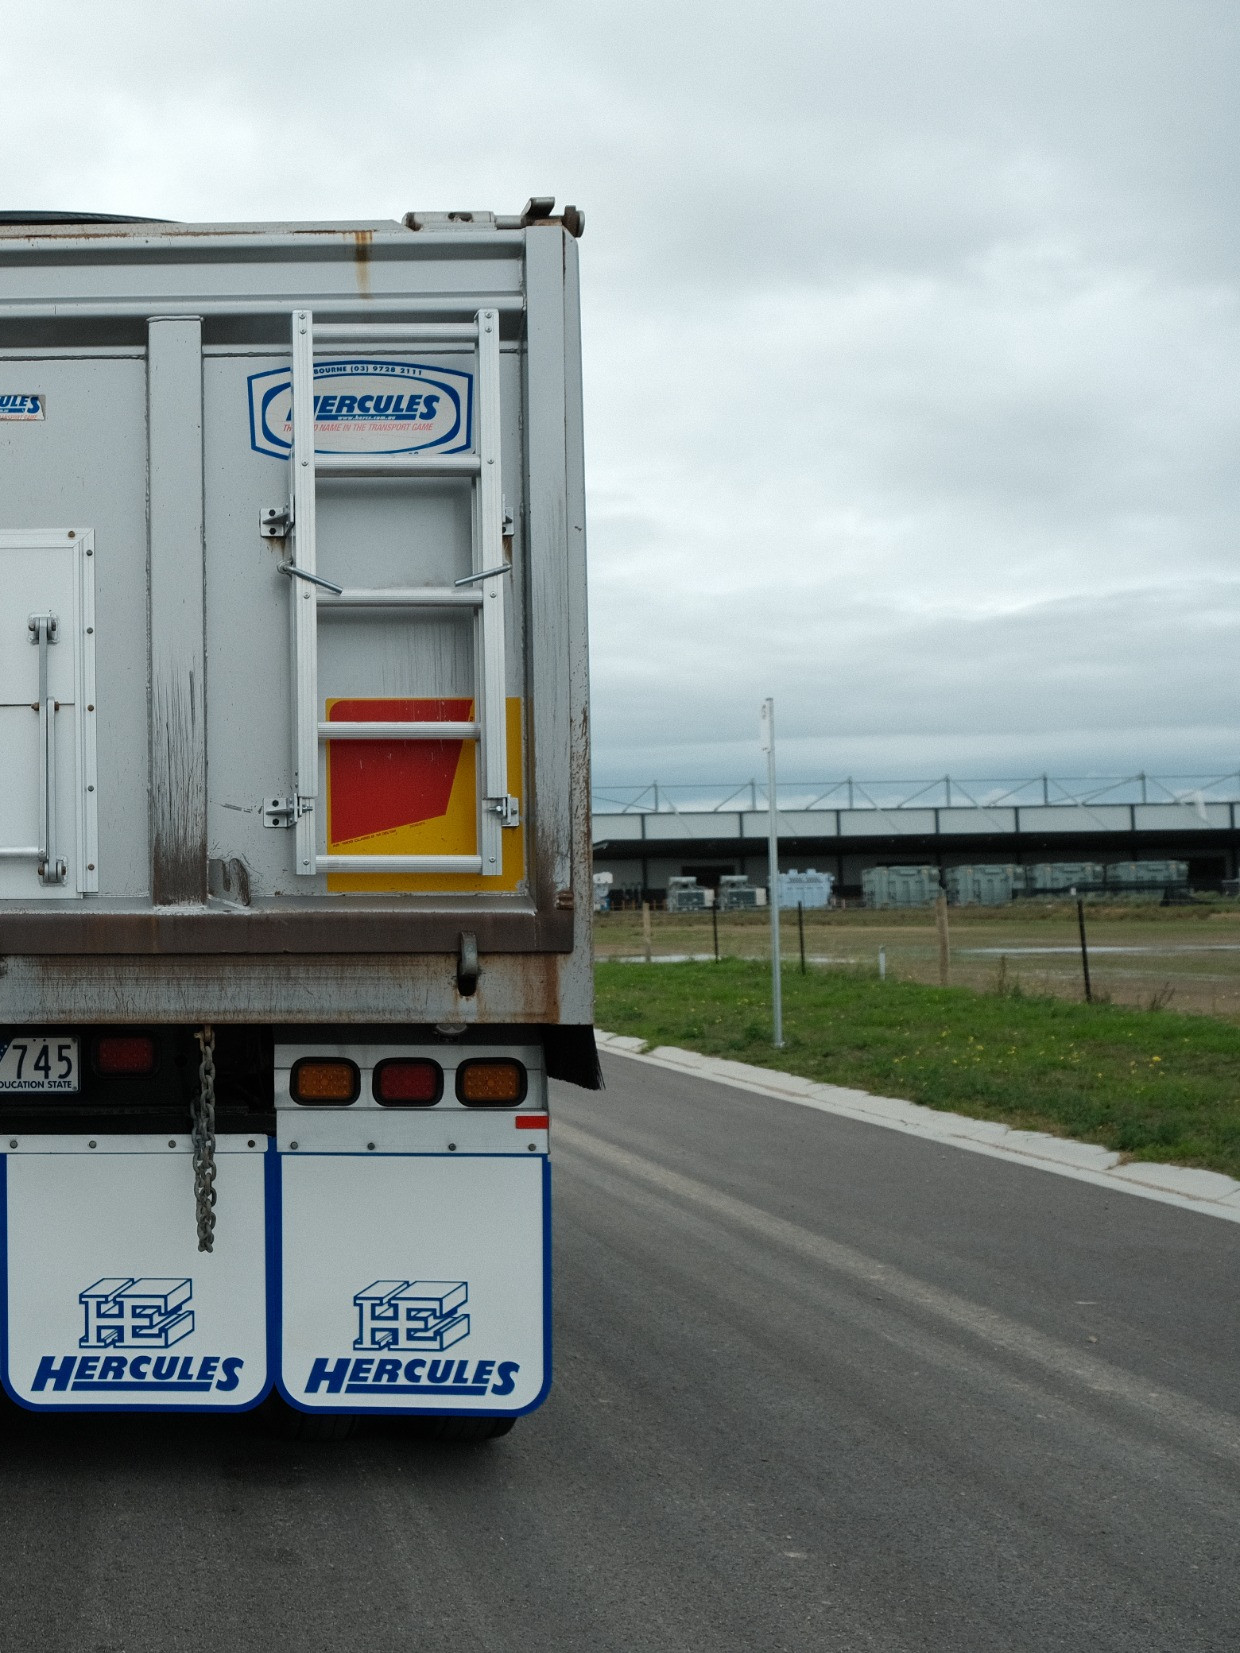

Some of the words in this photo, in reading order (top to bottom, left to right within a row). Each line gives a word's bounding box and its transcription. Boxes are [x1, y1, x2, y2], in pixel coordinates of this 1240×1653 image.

[313, 366, 347, 375] BOURNE
[350, 365, 369, 373] (03)
[372, 365, 395, 373] 9728
[400, 367, 422, 376] 2111
[368, 423, 411, 431] TRANSPORT
[412, 422, 434, 431] GAME
[12, 1044, 73, 1080] 745
[47, 1080, 73, 1089] STATE
[30, 1355, 244, 1392] HERCULES
[304, 1357, 520, 1396] HERCULES
